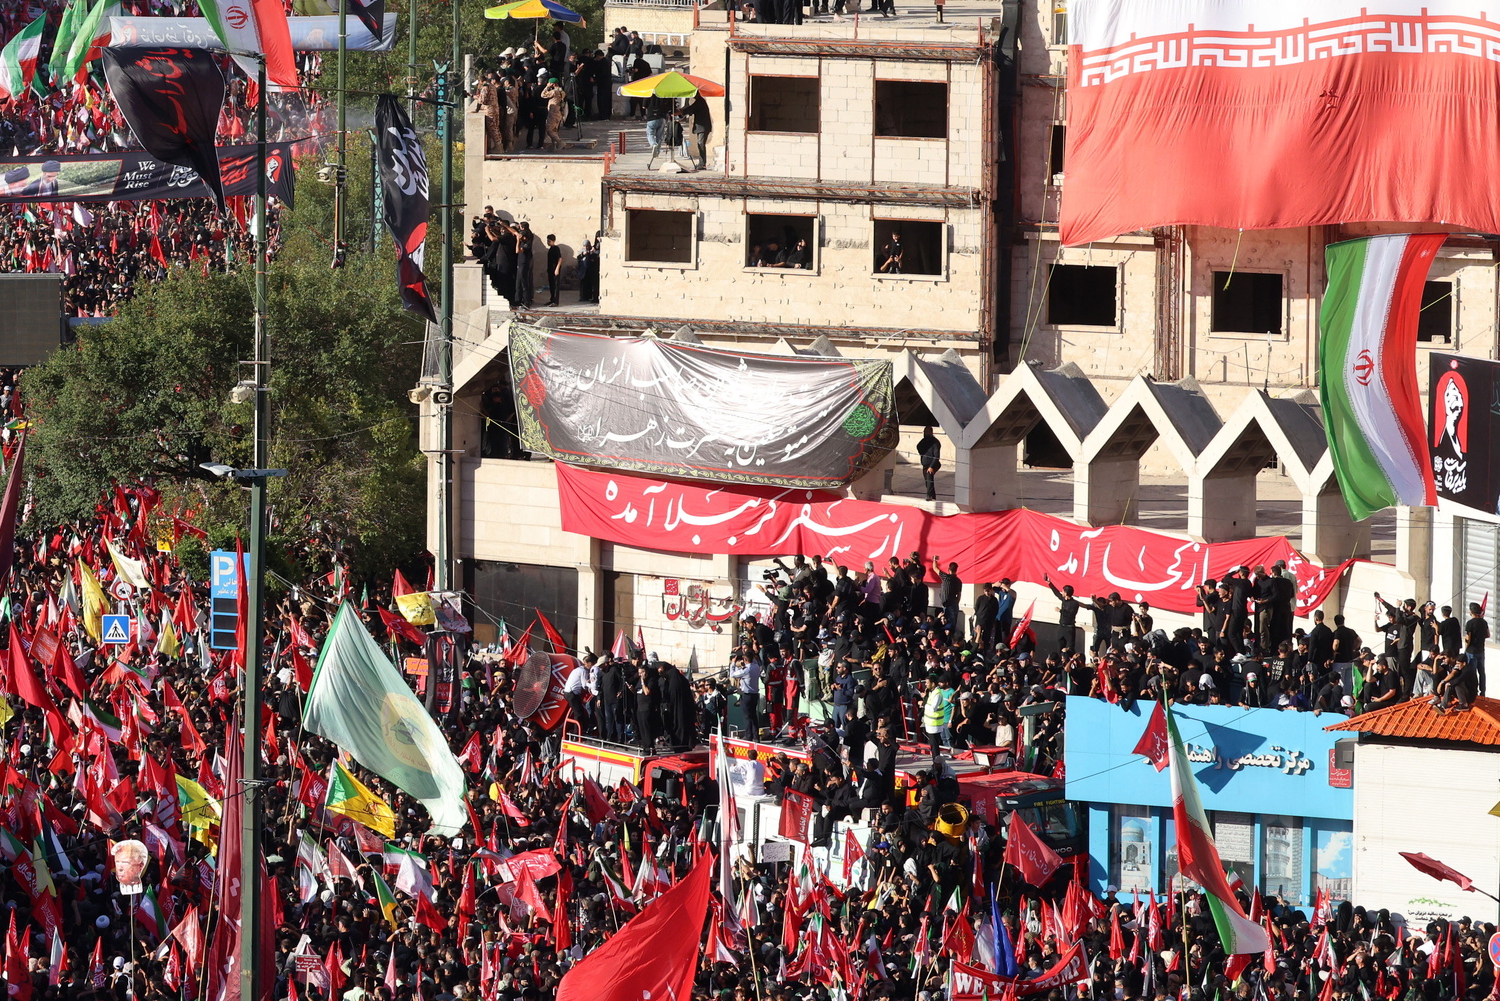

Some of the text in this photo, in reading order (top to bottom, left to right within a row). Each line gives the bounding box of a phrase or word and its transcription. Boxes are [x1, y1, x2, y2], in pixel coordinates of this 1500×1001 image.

[123, 171, 153, 181] Must
[138, 161, 156, 171] We
[125, 180, 149, 189] Rise
[578, 352, 632, 390] الزمان
[593, 415, 669, 448] زهرا
[605, 480, 905, 559] از سفر کربلا آمده
[1050, 527, 1105, 578] آمده
[1181, 541, 1210, 590] از
[213, 556, 235, 586] P
[1102, 541, 1198, 604] کجا
[666, 588, 709, 621] الزمان
[1185, 742, 1312, 777] مرکز تخصصی راهنما
[955, 972, 984, 997] WE
[1035, 956, 1082, 989] TRUMP
